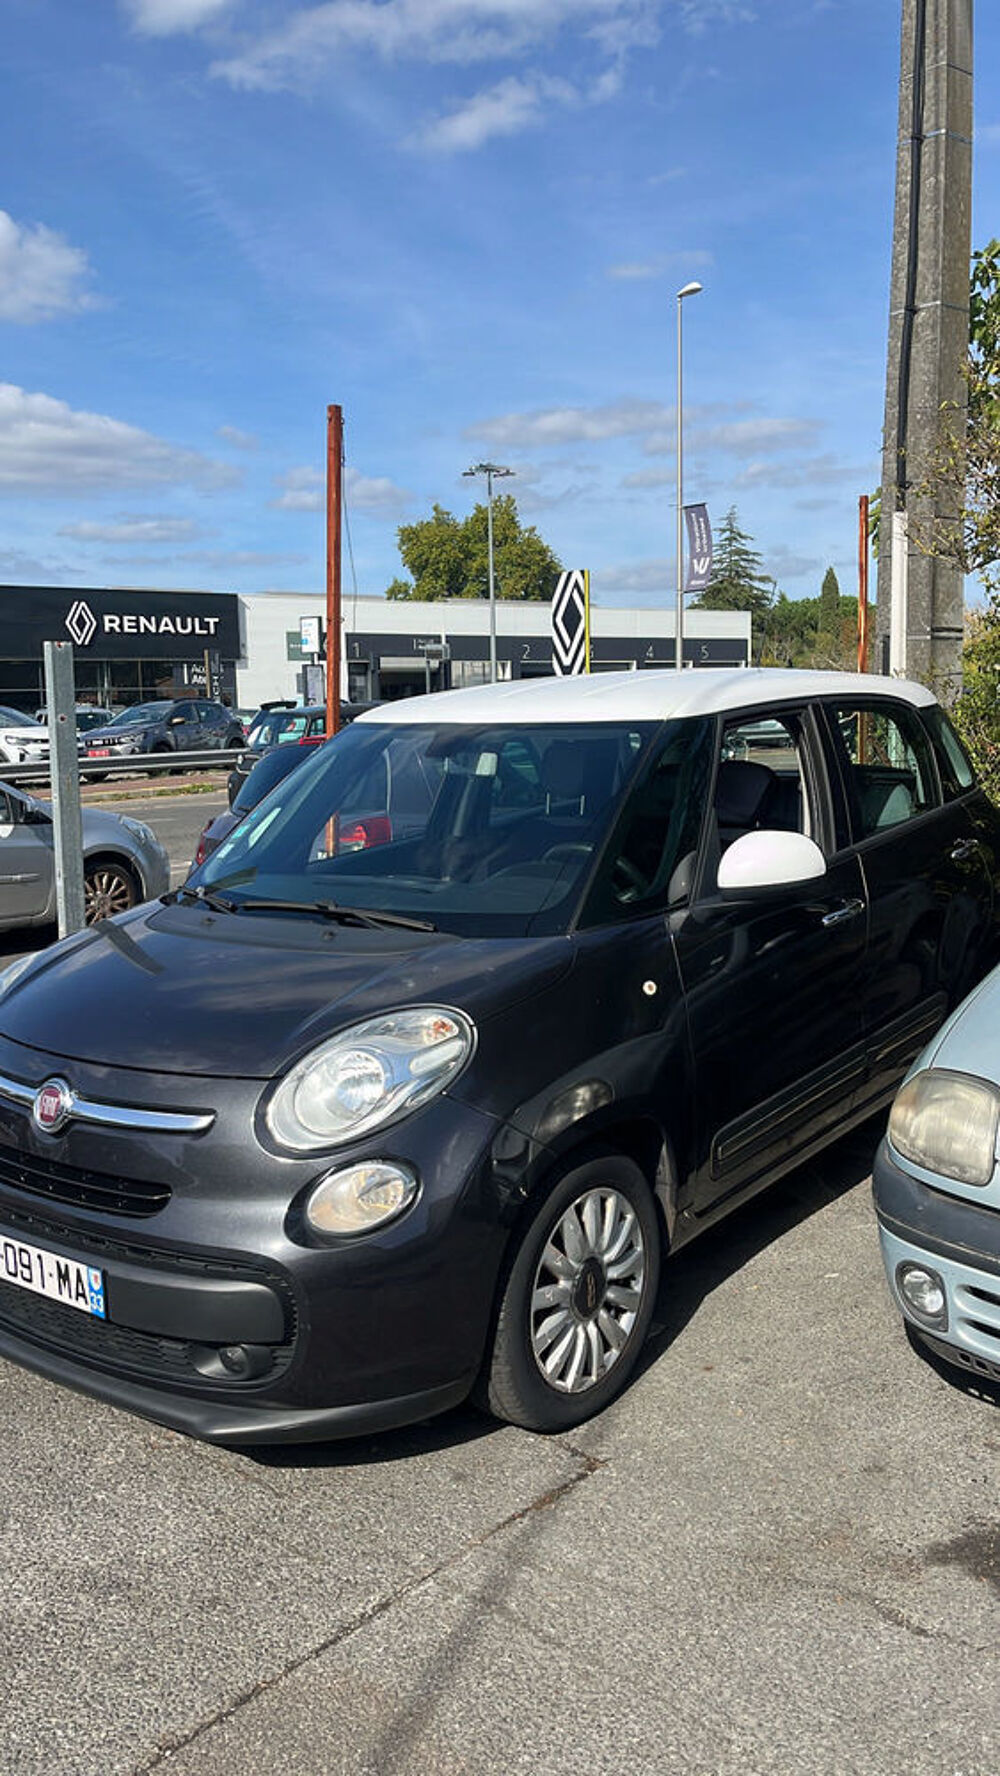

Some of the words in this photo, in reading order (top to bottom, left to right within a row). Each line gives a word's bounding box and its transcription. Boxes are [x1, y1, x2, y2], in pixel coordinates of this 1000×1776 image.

[103, 614, 220, 635] RENAULT
[522, 644, 531, 659] 2
[646, 645, 654, 658] 4
[700, 645, 709, 659] 5
[90, 1292, 104, 1313] 33
